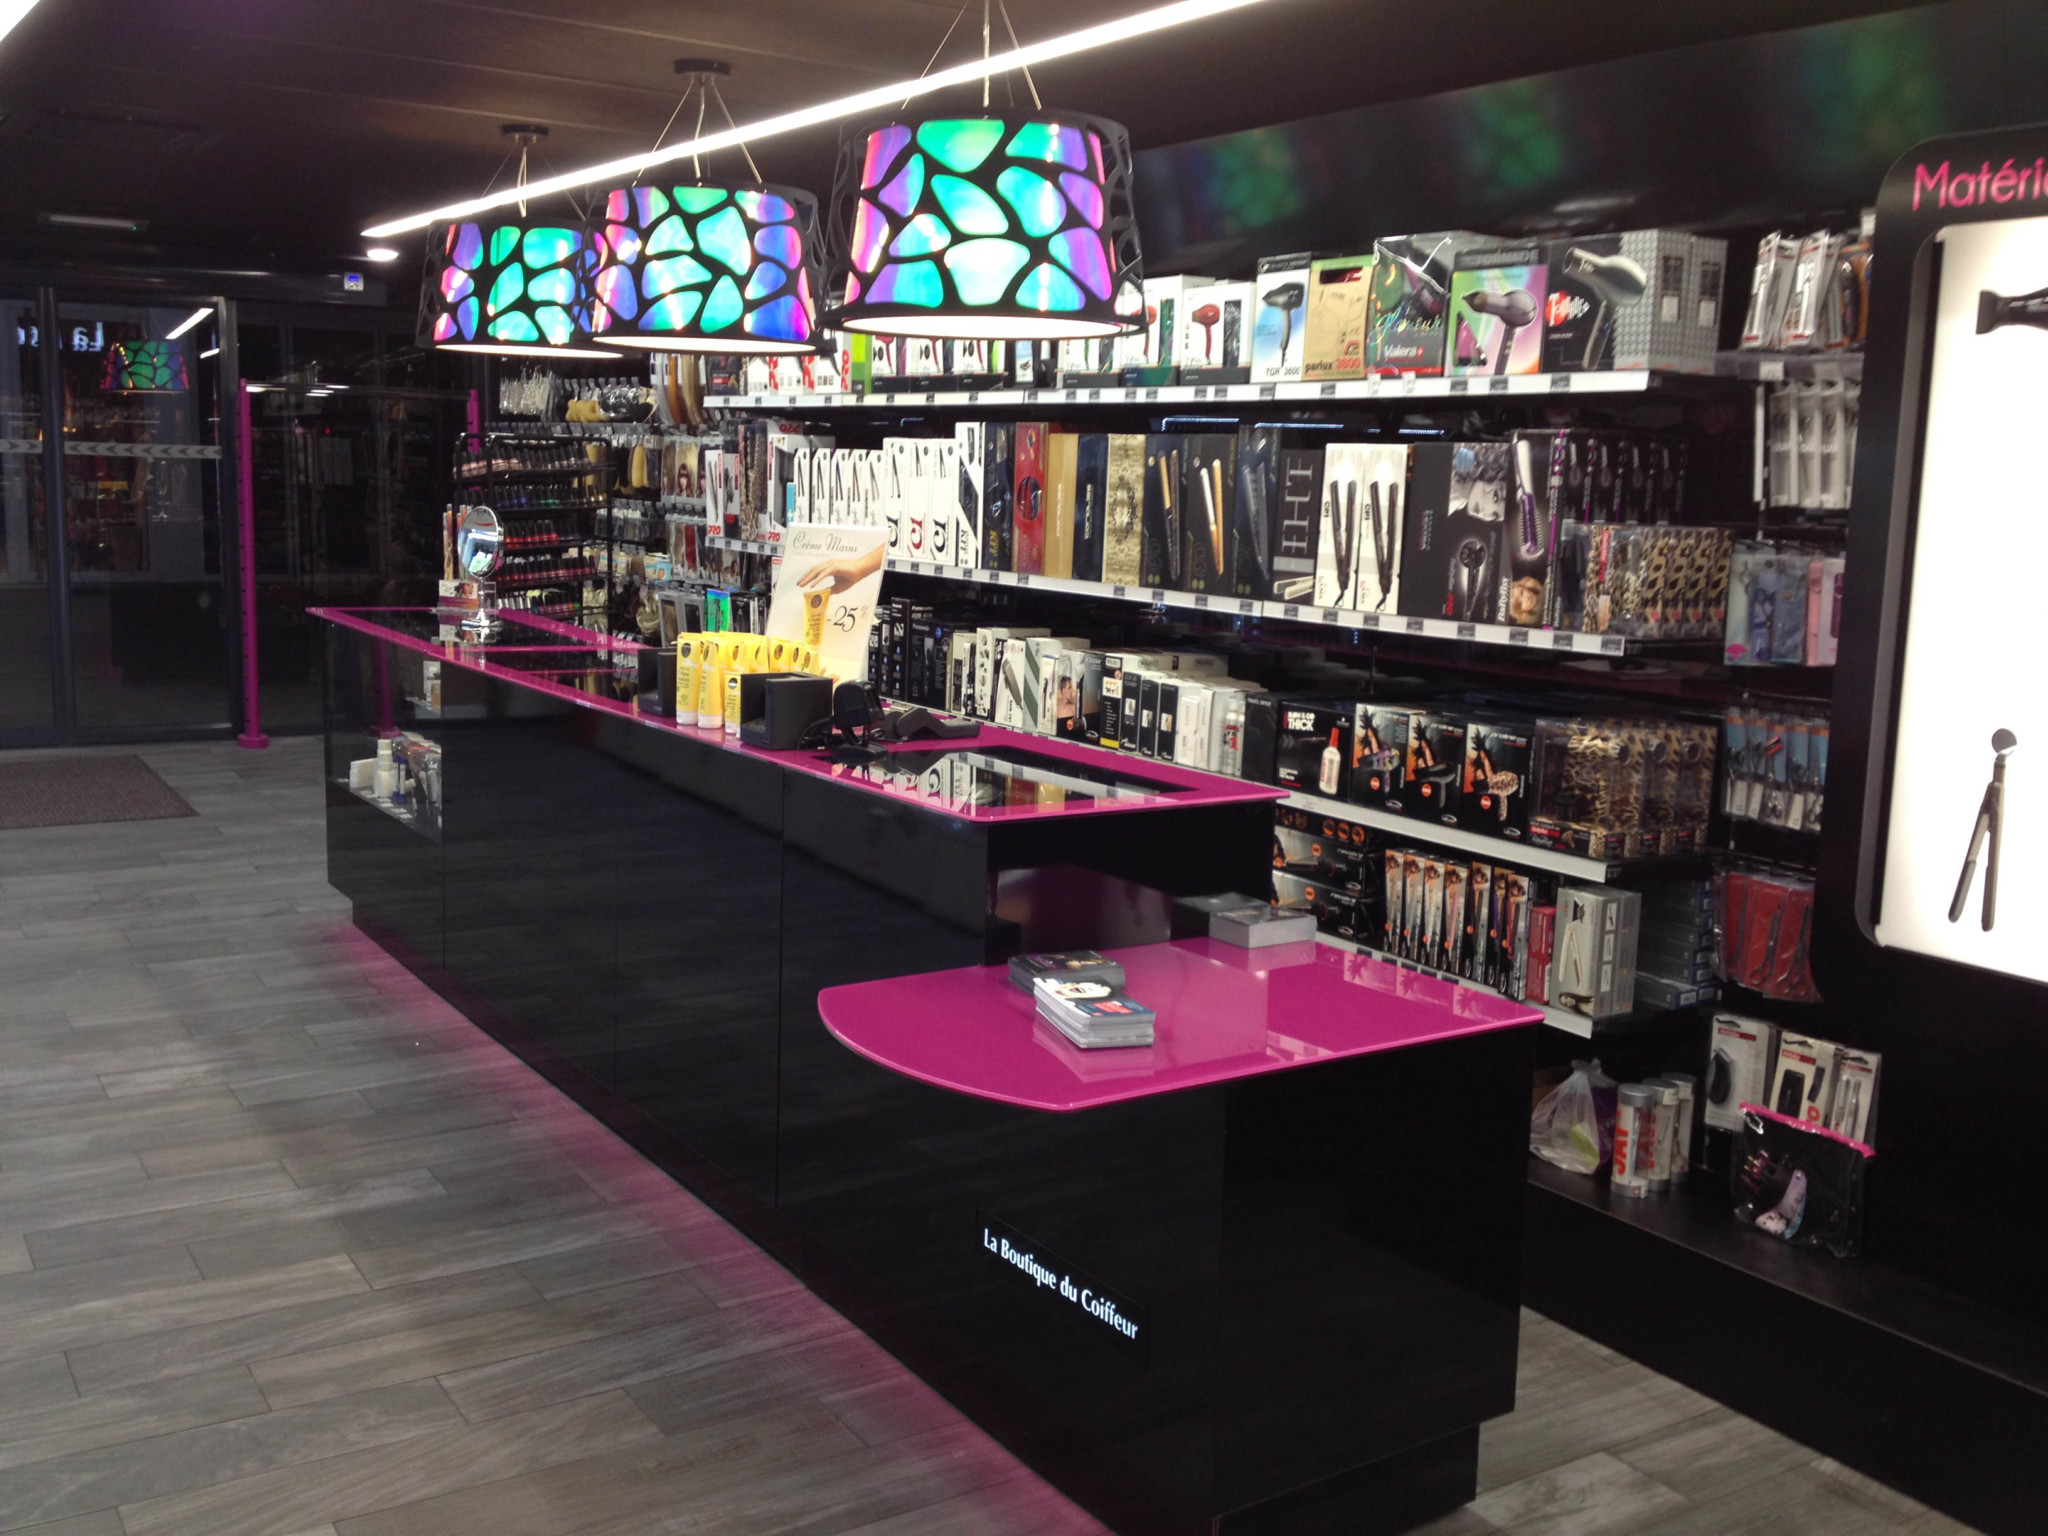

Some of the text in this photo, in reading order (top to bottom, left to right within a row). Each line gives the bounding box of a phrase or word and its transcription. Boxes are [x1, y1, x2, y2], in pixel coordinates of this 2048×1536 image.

[1384, 344, 1417, 358] Valera
[1305, 360, 1333, 374] parlux
[792, 530, 858, 553] Crème Mains
[1287, 718, 1315, 732] THICK
[983, 1228, 1139, 1340] La Boutique du Coiffeur
